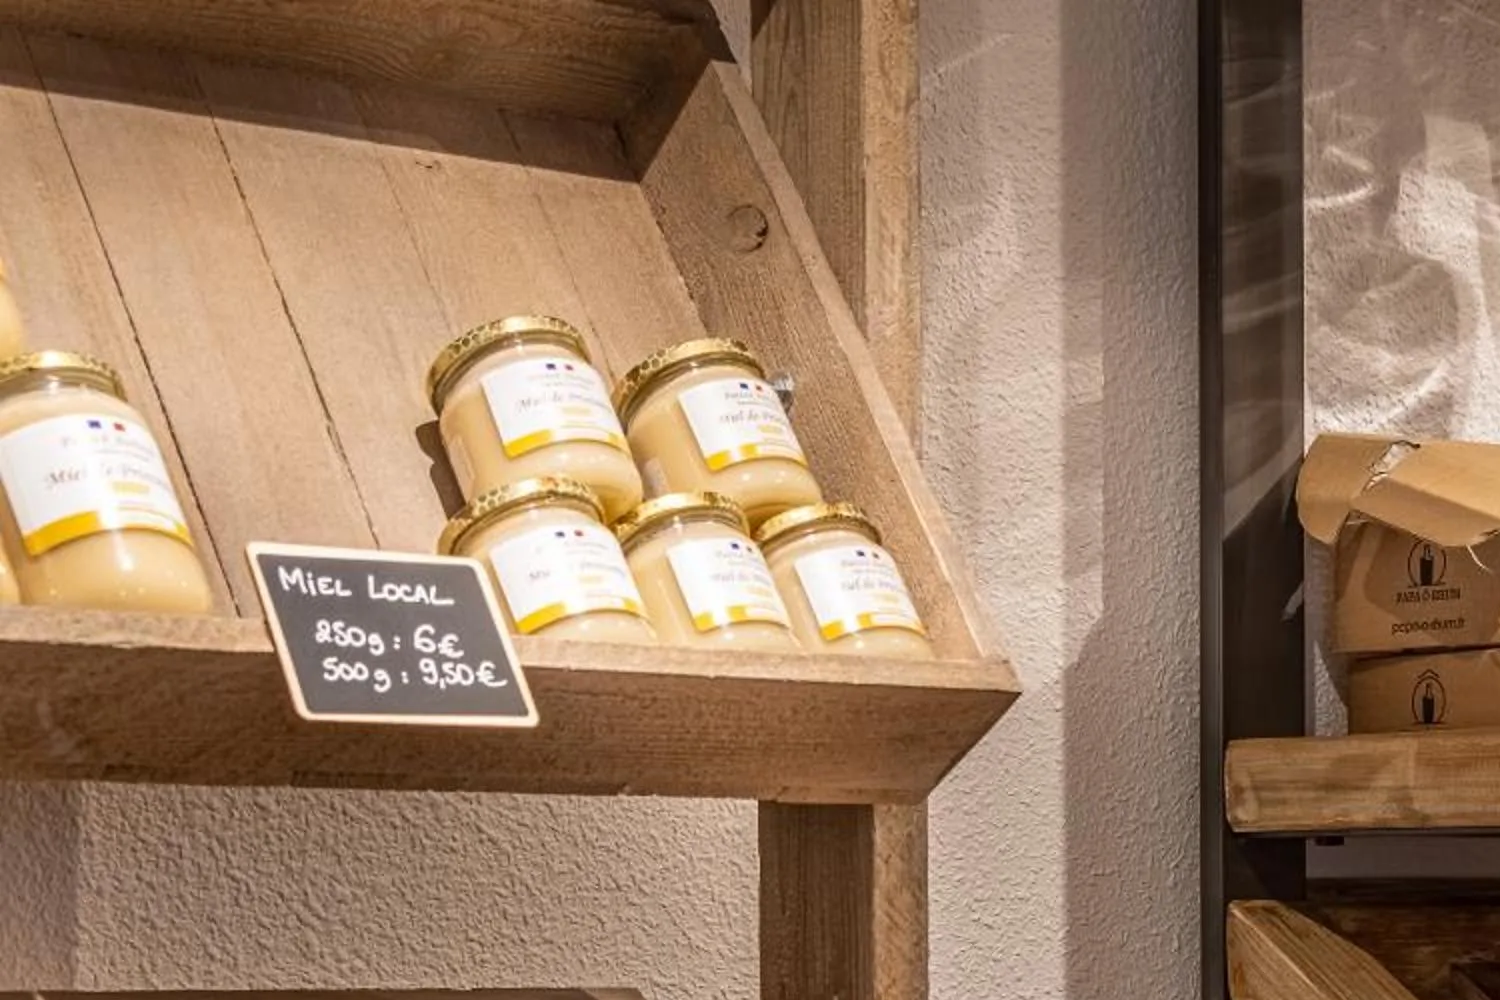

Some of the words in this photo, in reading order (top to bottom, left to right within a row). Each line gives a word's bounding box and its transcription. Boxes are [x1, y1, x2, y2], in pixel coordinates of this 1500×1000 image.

[367, 575, 455, 605] LOCAL
[413, 624, 464, 658] 6€
[419, 658, 509, 690] 9,50€
